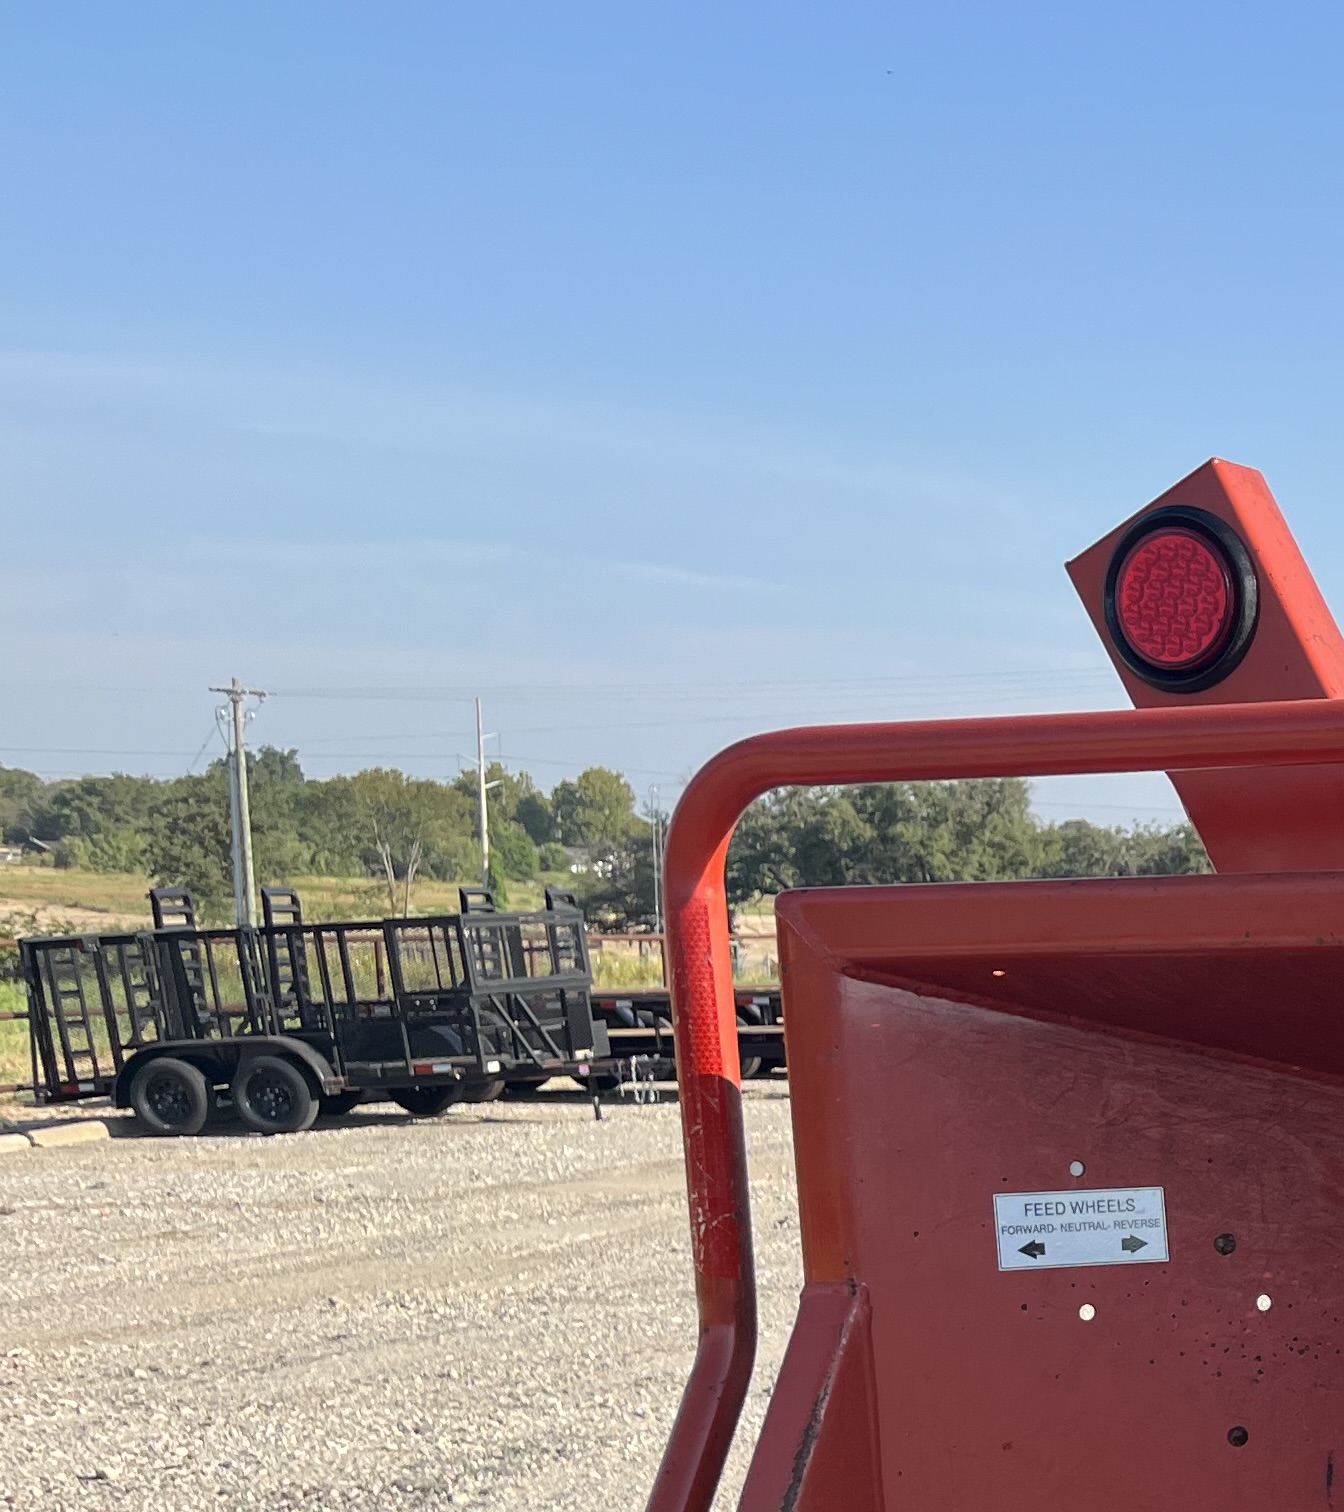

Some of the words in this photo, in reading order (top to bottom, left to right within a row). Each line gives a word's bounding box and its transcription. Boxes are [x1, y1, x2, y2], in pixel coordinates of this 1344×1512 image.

[1024, 1202, 1066, 1216] FEED
[1070, 1199, 1136, 1215] WHEELS
[1001, 1224, 1057, 1235] FORWARD-
[1060, 1221, 1111, 1232] NEUTRAL-
[1114, 1218, 1160, 1229] REVERSE
